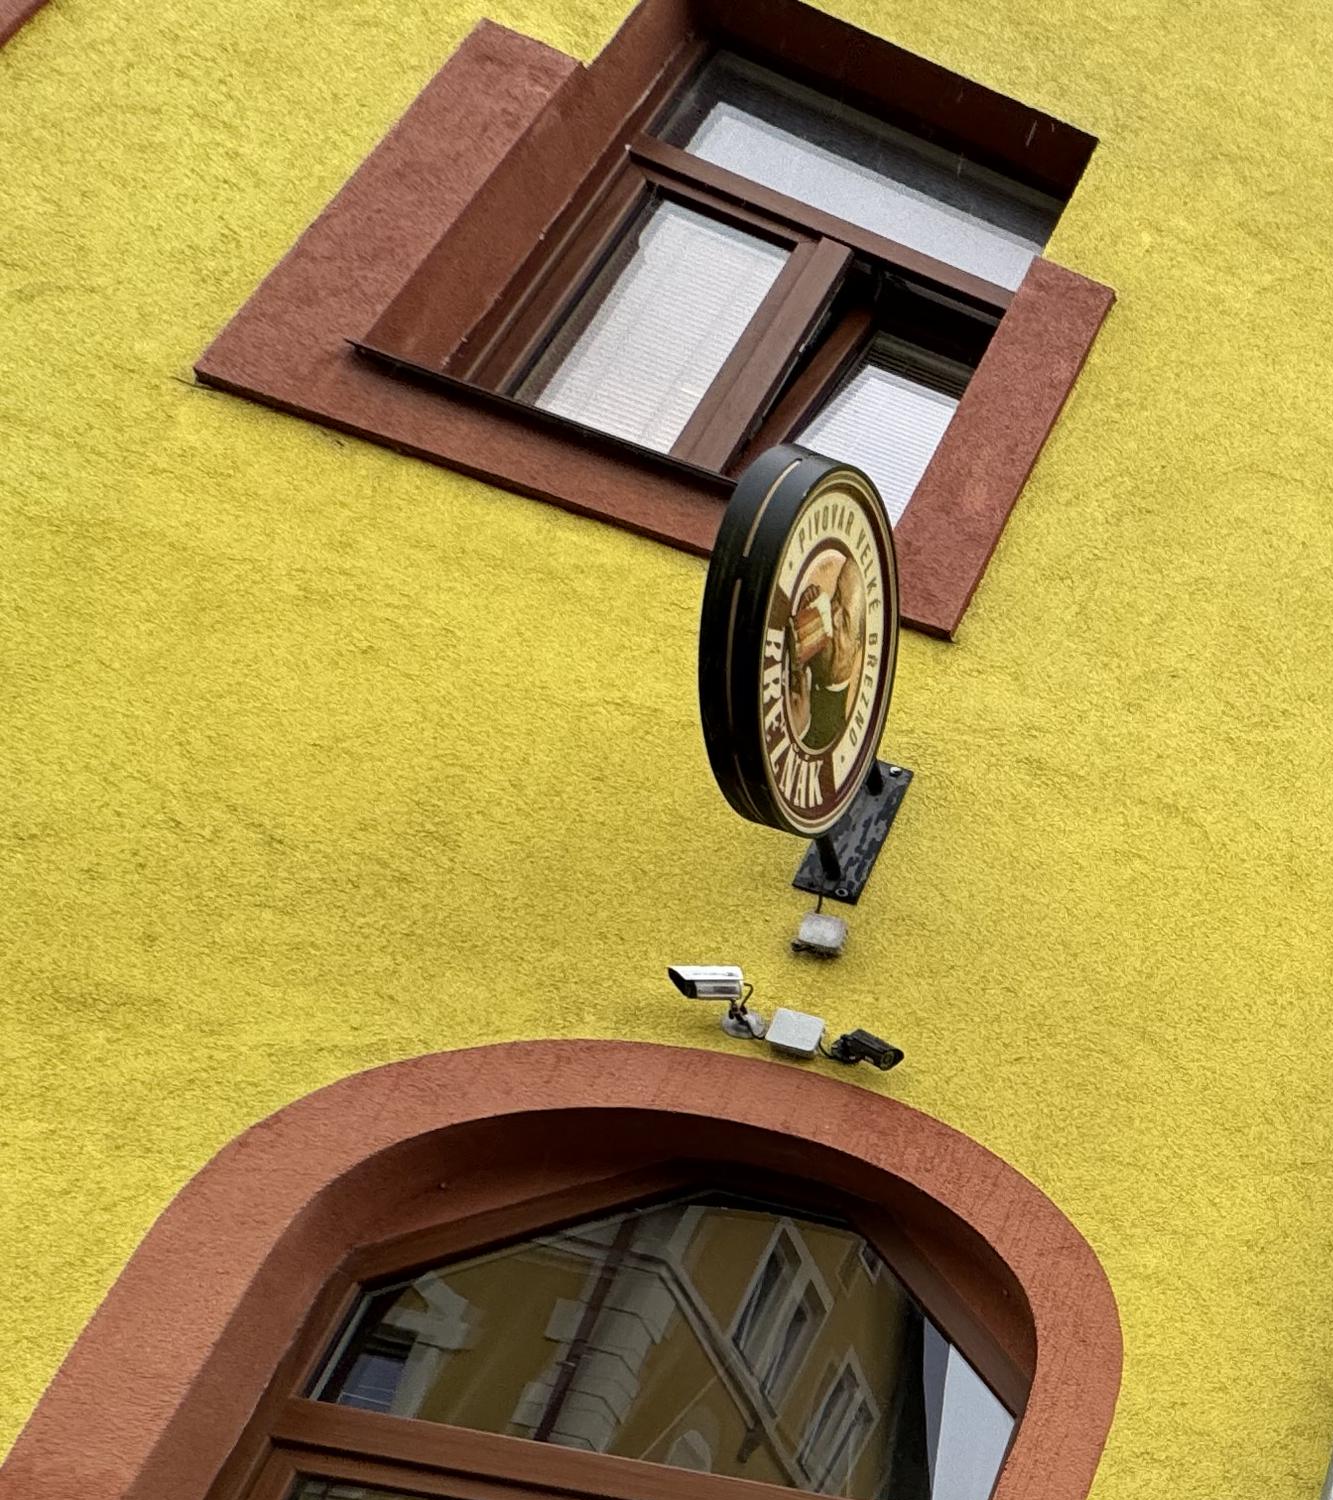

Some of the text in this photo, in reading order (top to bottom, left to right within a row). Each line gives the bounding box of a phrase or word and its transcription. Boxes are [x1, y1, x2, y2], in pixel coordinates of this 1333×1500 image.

[798, 503, 855, 554] PIVOVAR
[856, 528, 881, 614] VELKÉ
[762, 626, 824, 809] BŘEZŇÁK
